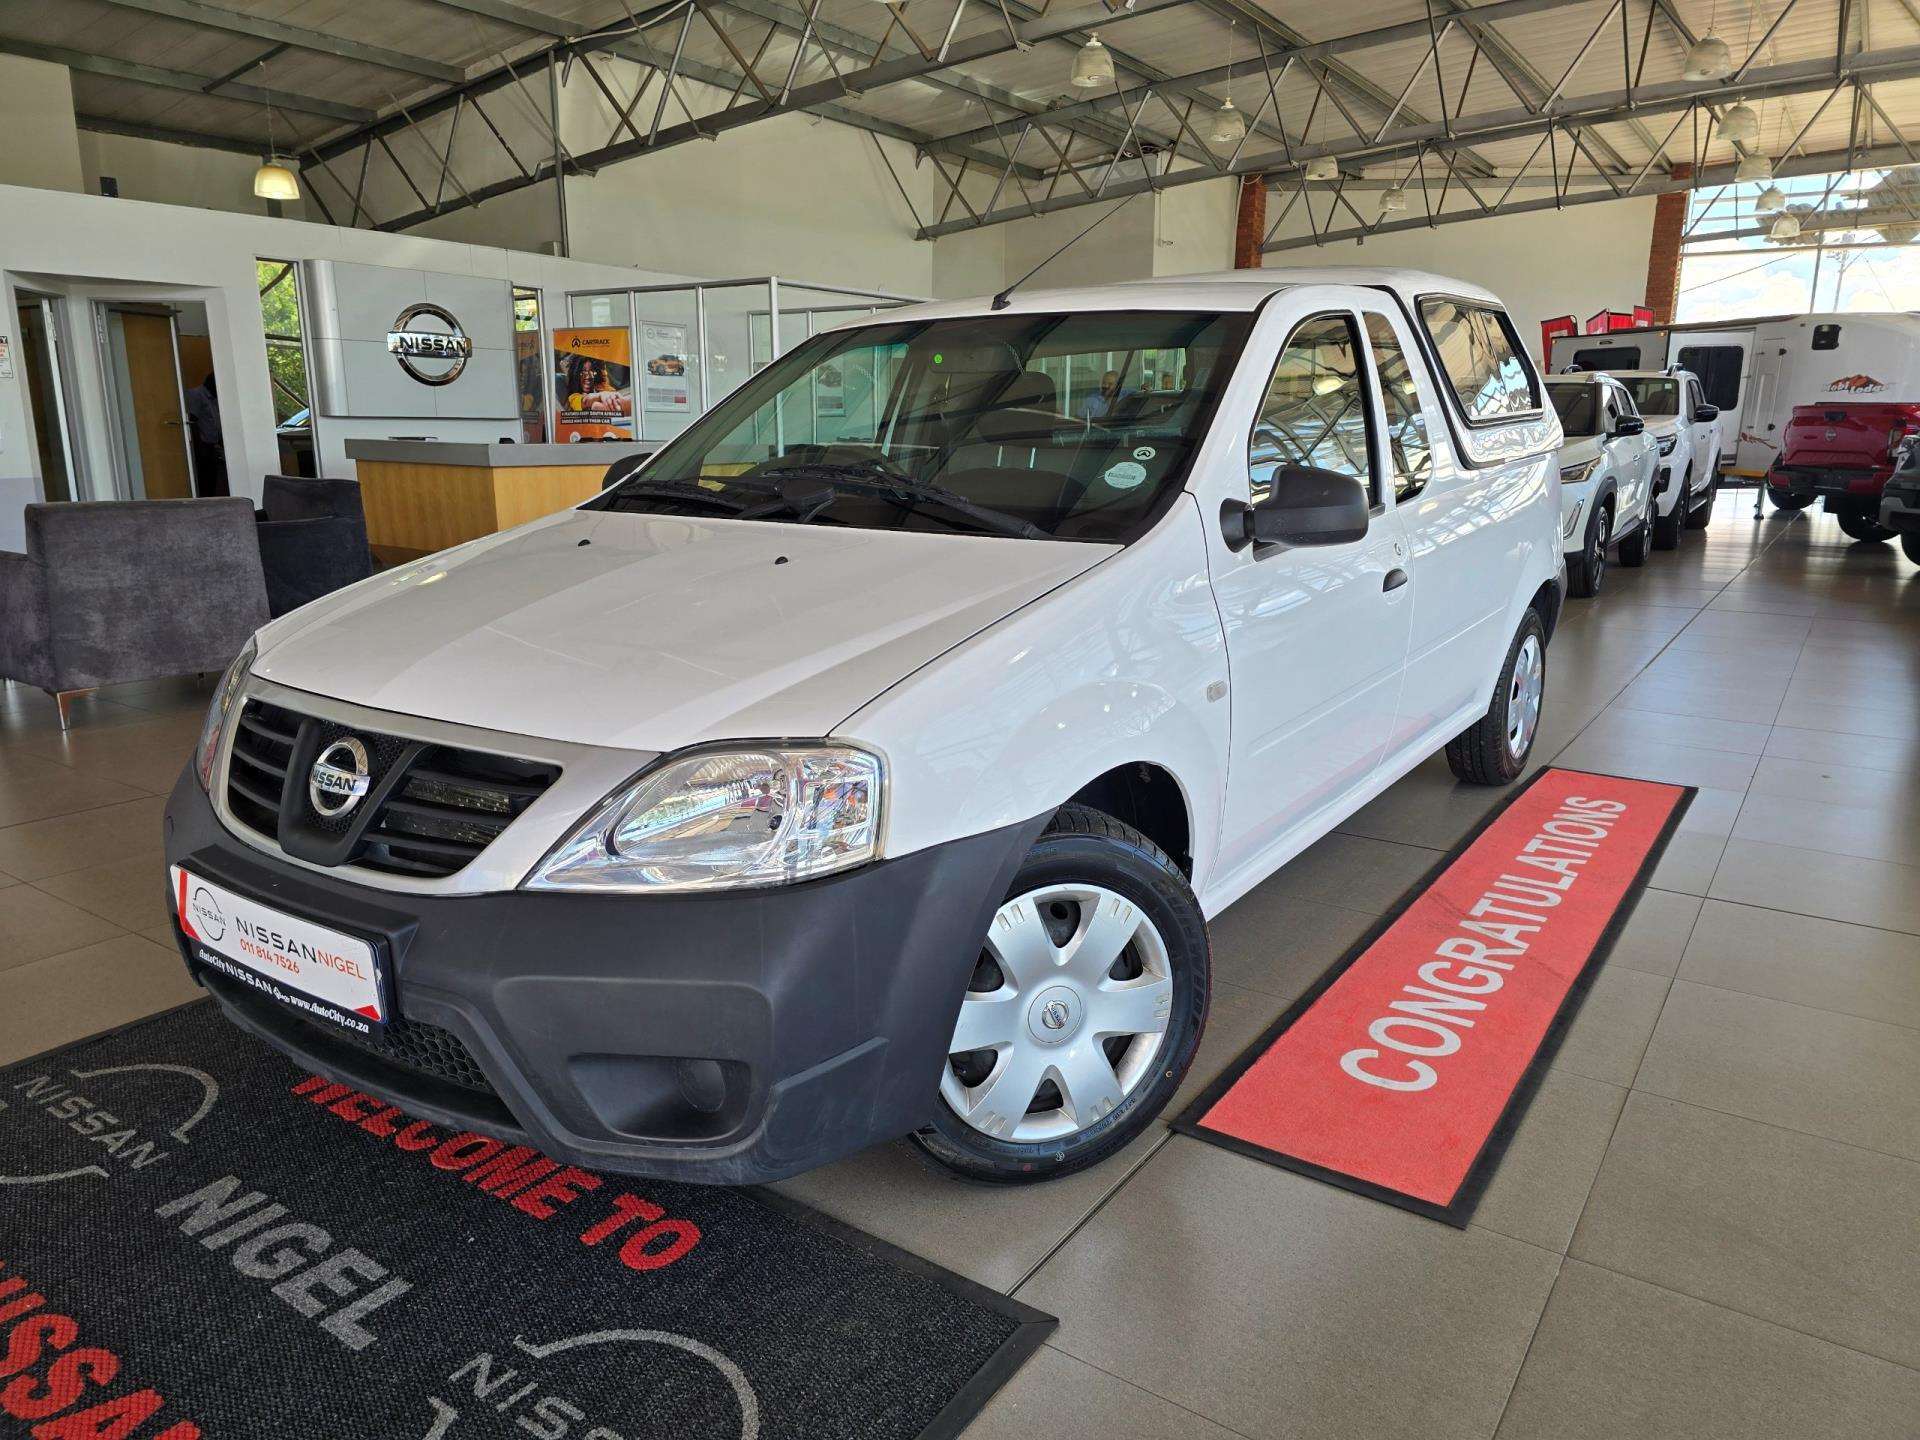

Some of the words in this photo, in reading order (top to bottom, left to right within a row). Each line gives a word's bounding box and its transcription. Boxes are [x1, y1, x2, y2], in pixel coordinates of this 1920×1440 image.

[399, 335, 466, 353] NISSAN
[192, 903, 227, 927] NISSAN
[240, 938, 255, 955] 011
[256, 946, 273, 962] 814
[274, 953, 300, 974] 7526
[1340, 796, 1627, 1092] CONGRATULATIONS
[199, 949, 225, 972] AutoCity
[224, 962, 273, 995] NISSAN
[290, 995, 369, 1034] www.AutoCity.co.za
[14, 1076, 171, 1170] NISSAN
[291, 1076, 602, 1220] WELCOME
[580, 1192, 701, 1271] TO
[154, 1174, 415, 1351] NIGEL
[0, 1260, 202, 1440] SSA
